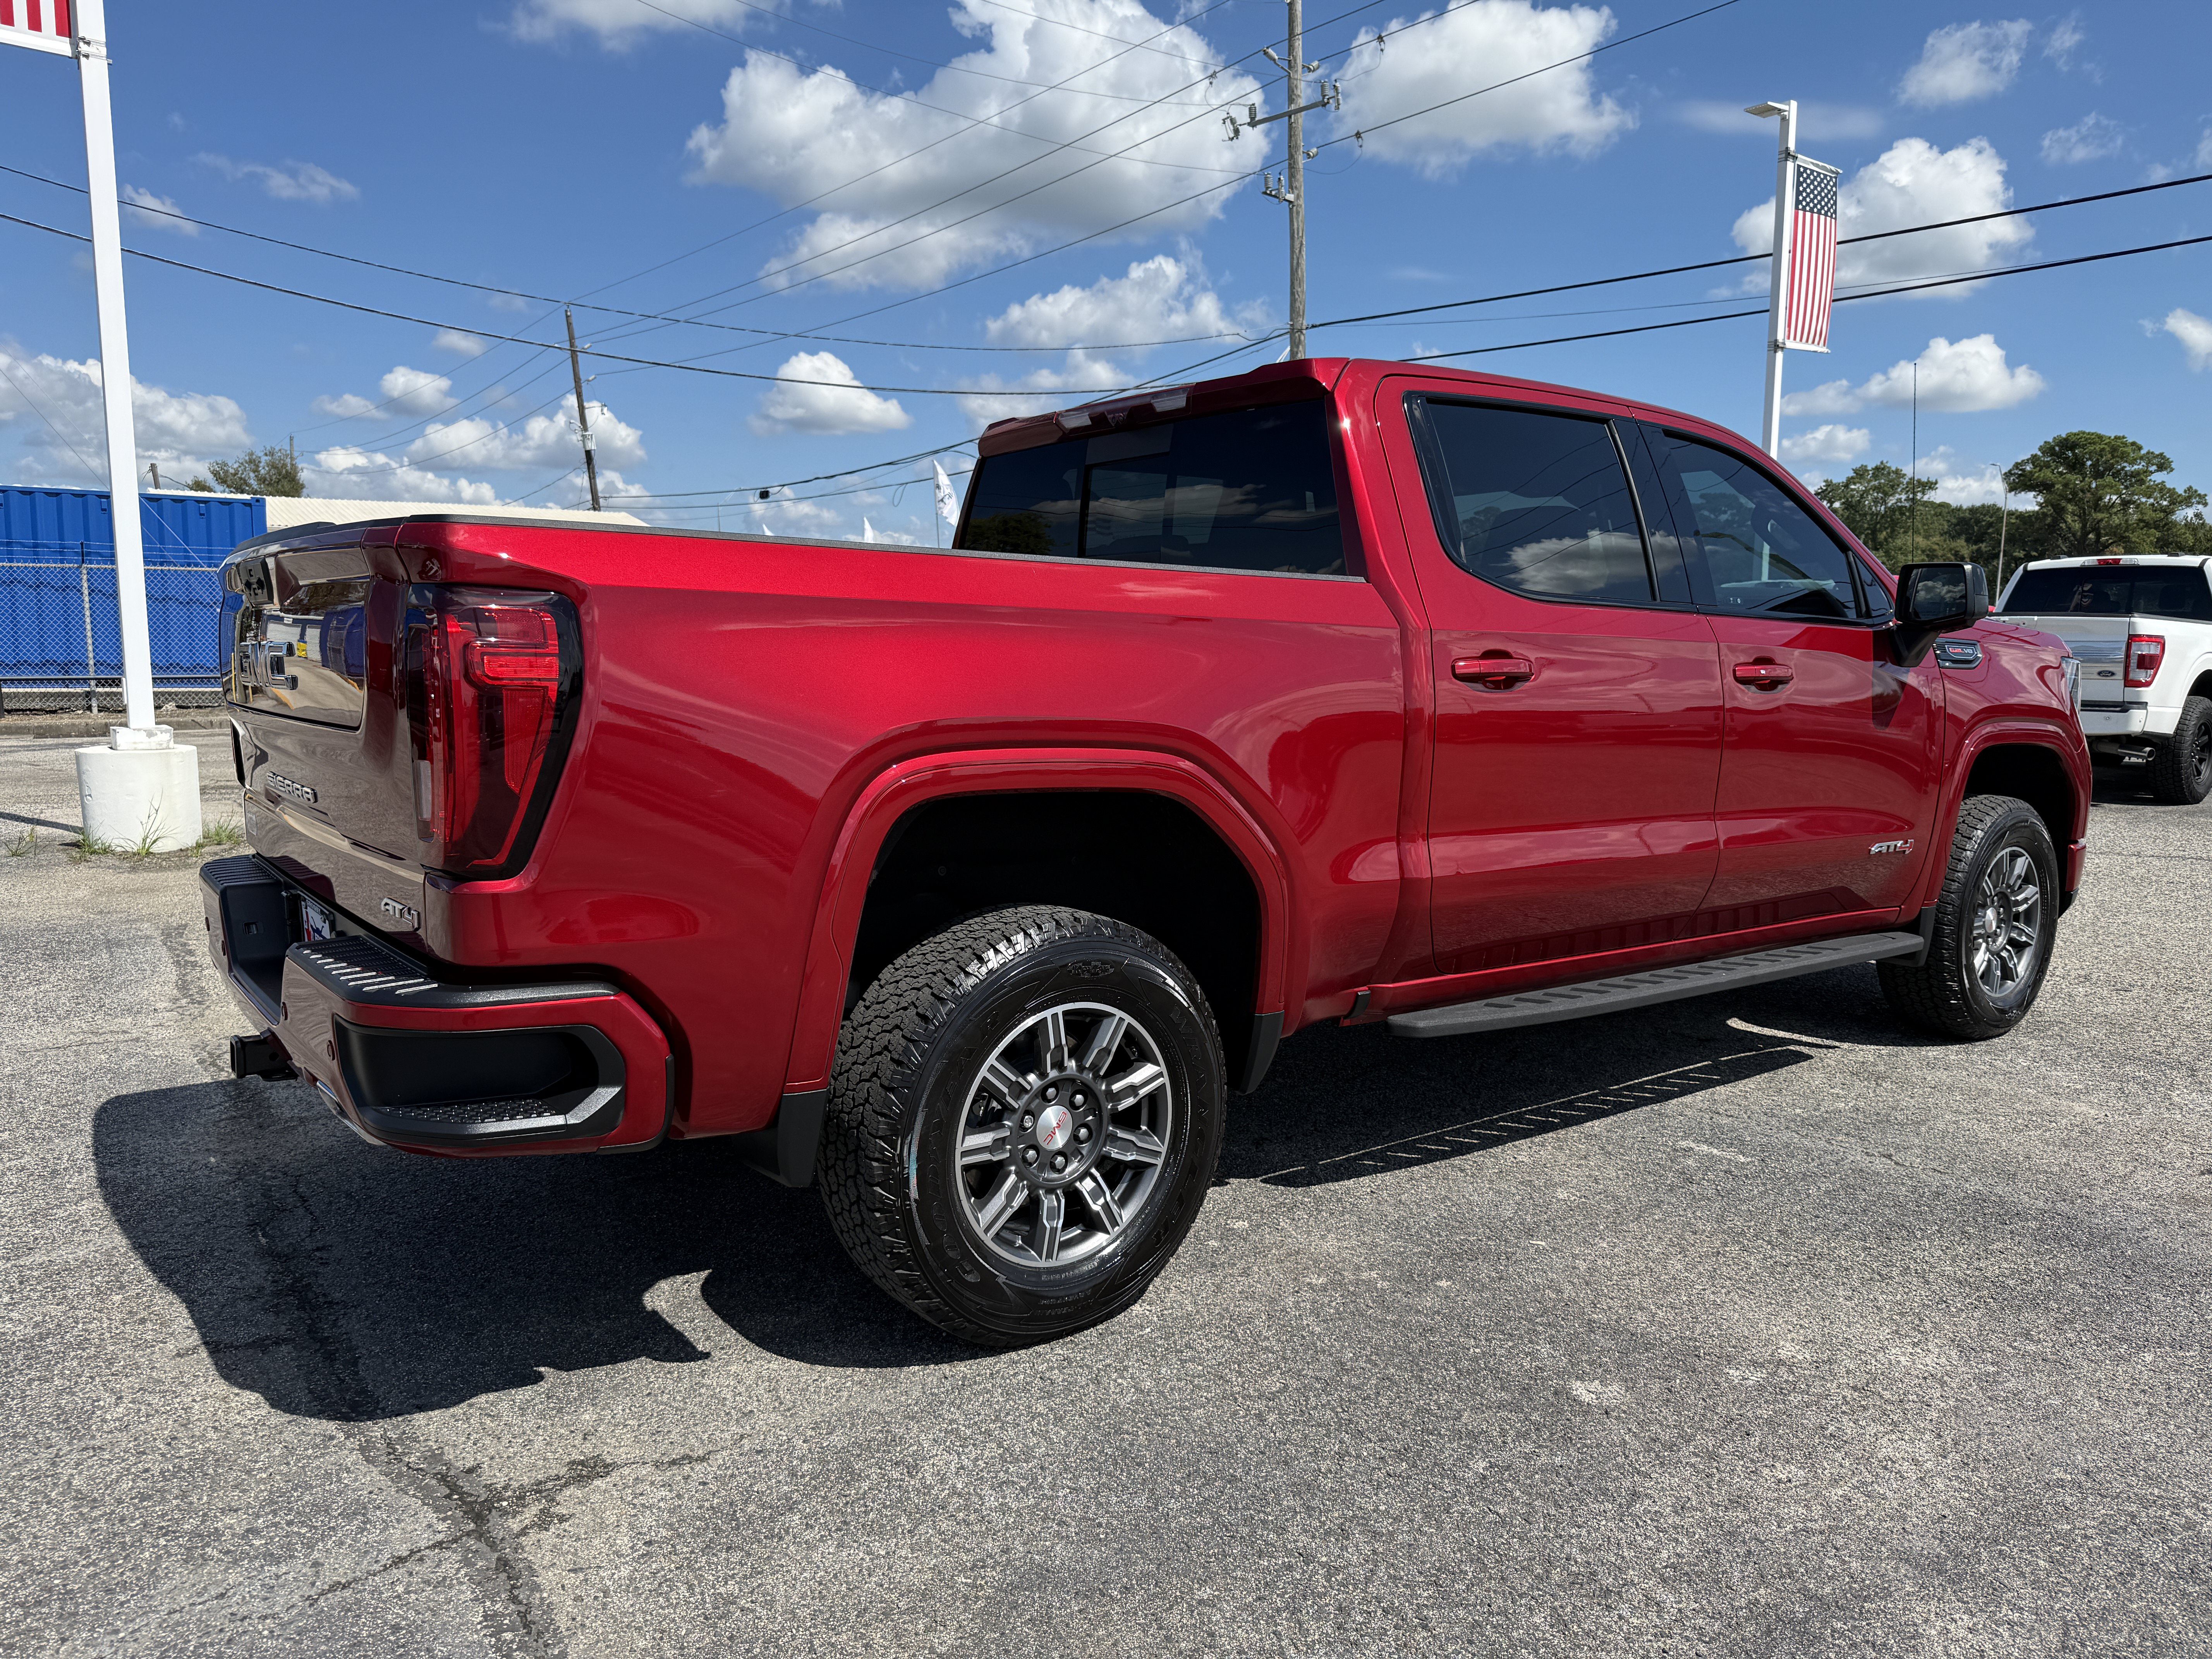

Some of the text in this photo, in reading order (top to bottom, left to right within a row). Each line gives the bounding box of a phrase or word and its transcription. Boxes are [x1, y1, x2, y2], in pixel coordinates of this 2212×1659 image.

[239, 641, 298, 690] GMC
[266, 771, 318, 804] SIERRA
[1868, 839, 1914, 855] AT4
[381, 897, 421, 932] AT4
[1044, 1111, 1068, 1146] GMC
[1152, 1003, 1209, 1248] WRANGLER
[926, 1009, 1001, 1283] GOODYEAR
